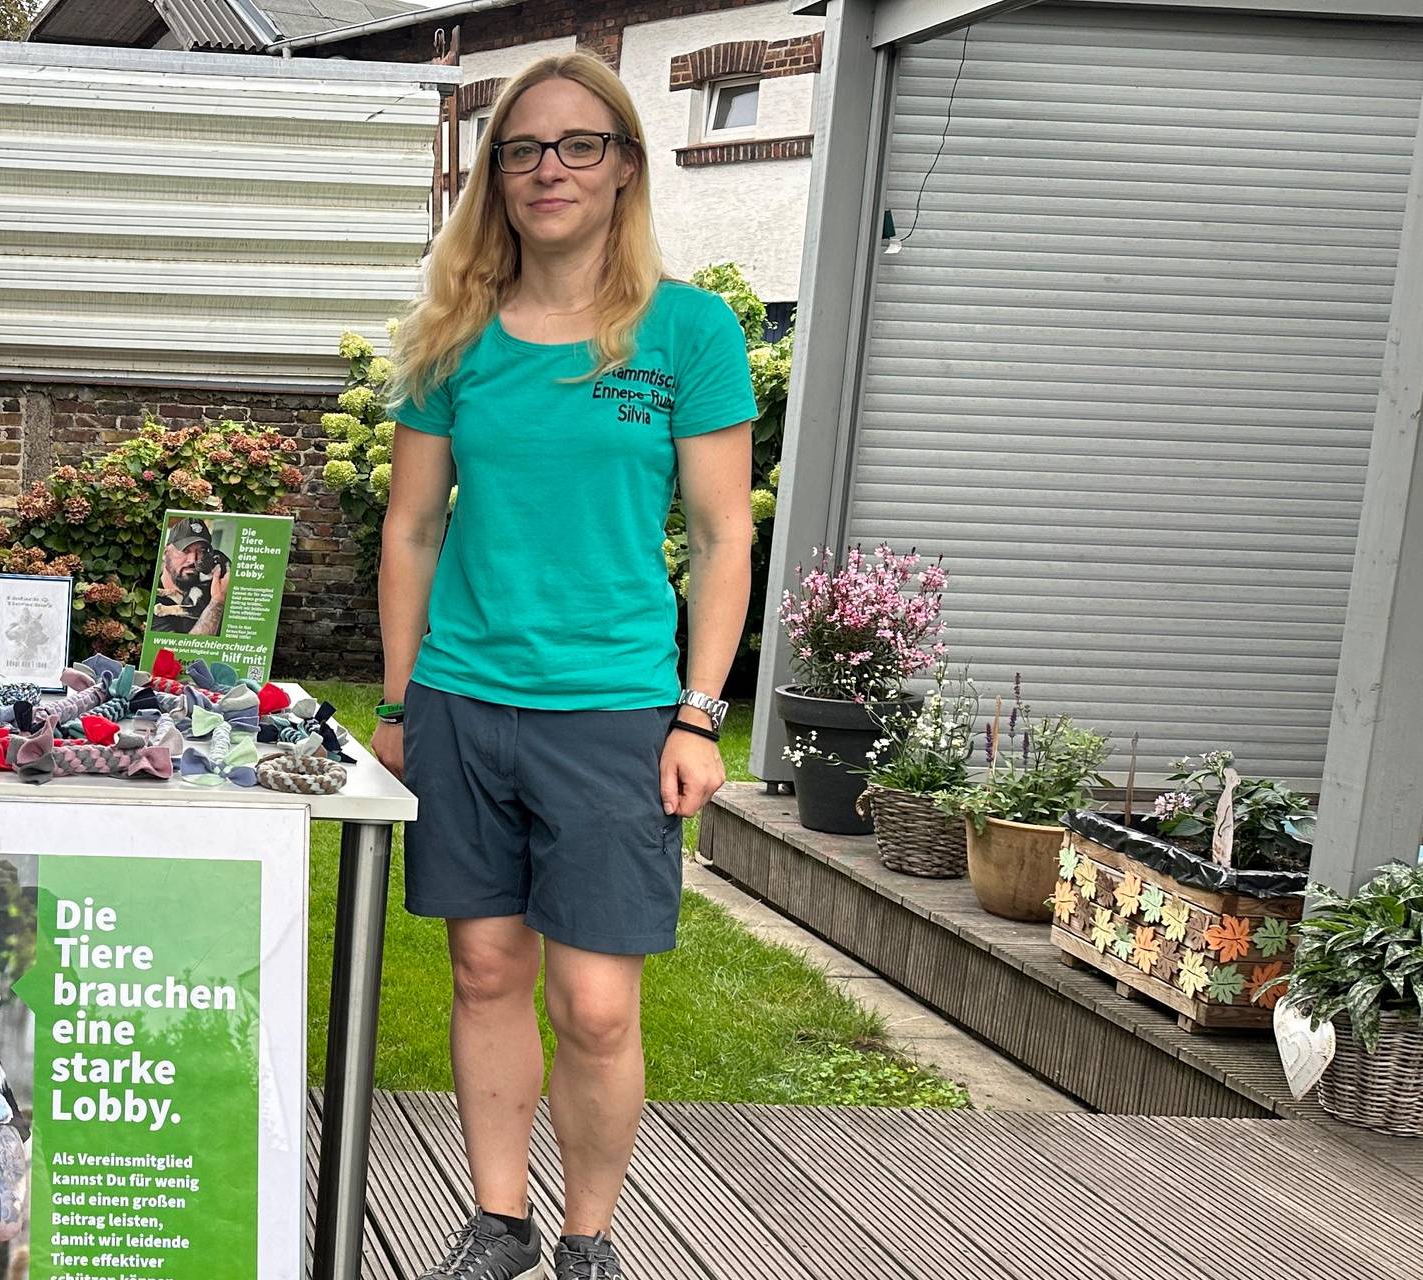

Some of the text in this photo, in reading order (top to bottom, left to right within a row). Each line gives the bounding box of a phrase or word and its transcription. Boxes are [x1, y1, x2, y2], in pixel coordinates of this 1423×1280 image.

[617, 404, 651, 425] Silvia
[241, 527, 257, 537] Die
[241, 536, 264, 546] Tiere
[238, 553, 257, 562] eine
[239, 545, 282, 555] brauchen
[235, 569, 265, 580] Lobby.
[236, 561, 265, 571] starke
[153, 637, 268, 654] www.einfachtierschutz.de
[221, 651, 267, 666] hilf mit!
[55, 897, 117, 932] Die
[53, 934, 154, 970] Tiere
[53, 972, 236, 1010] brauchen
[52, 1009, 136, 1046] eine
[50, 1050, 176, 1085] starke
[51, 1088, 181, 1132] Lobby.
[51, 1151, 193, 1171] Als Vereinsmitglied
[52, 1171, 200, 1192] kannst Du für wenig
[51, 1192, 186, 1210] Geld einen großen
[51, 1212, 164, 1231] Beitrag leisten,
[50, 1231, 190, 1249] damit wir leidende
[50, 1251, 165, 1269] Tiere effektiver
